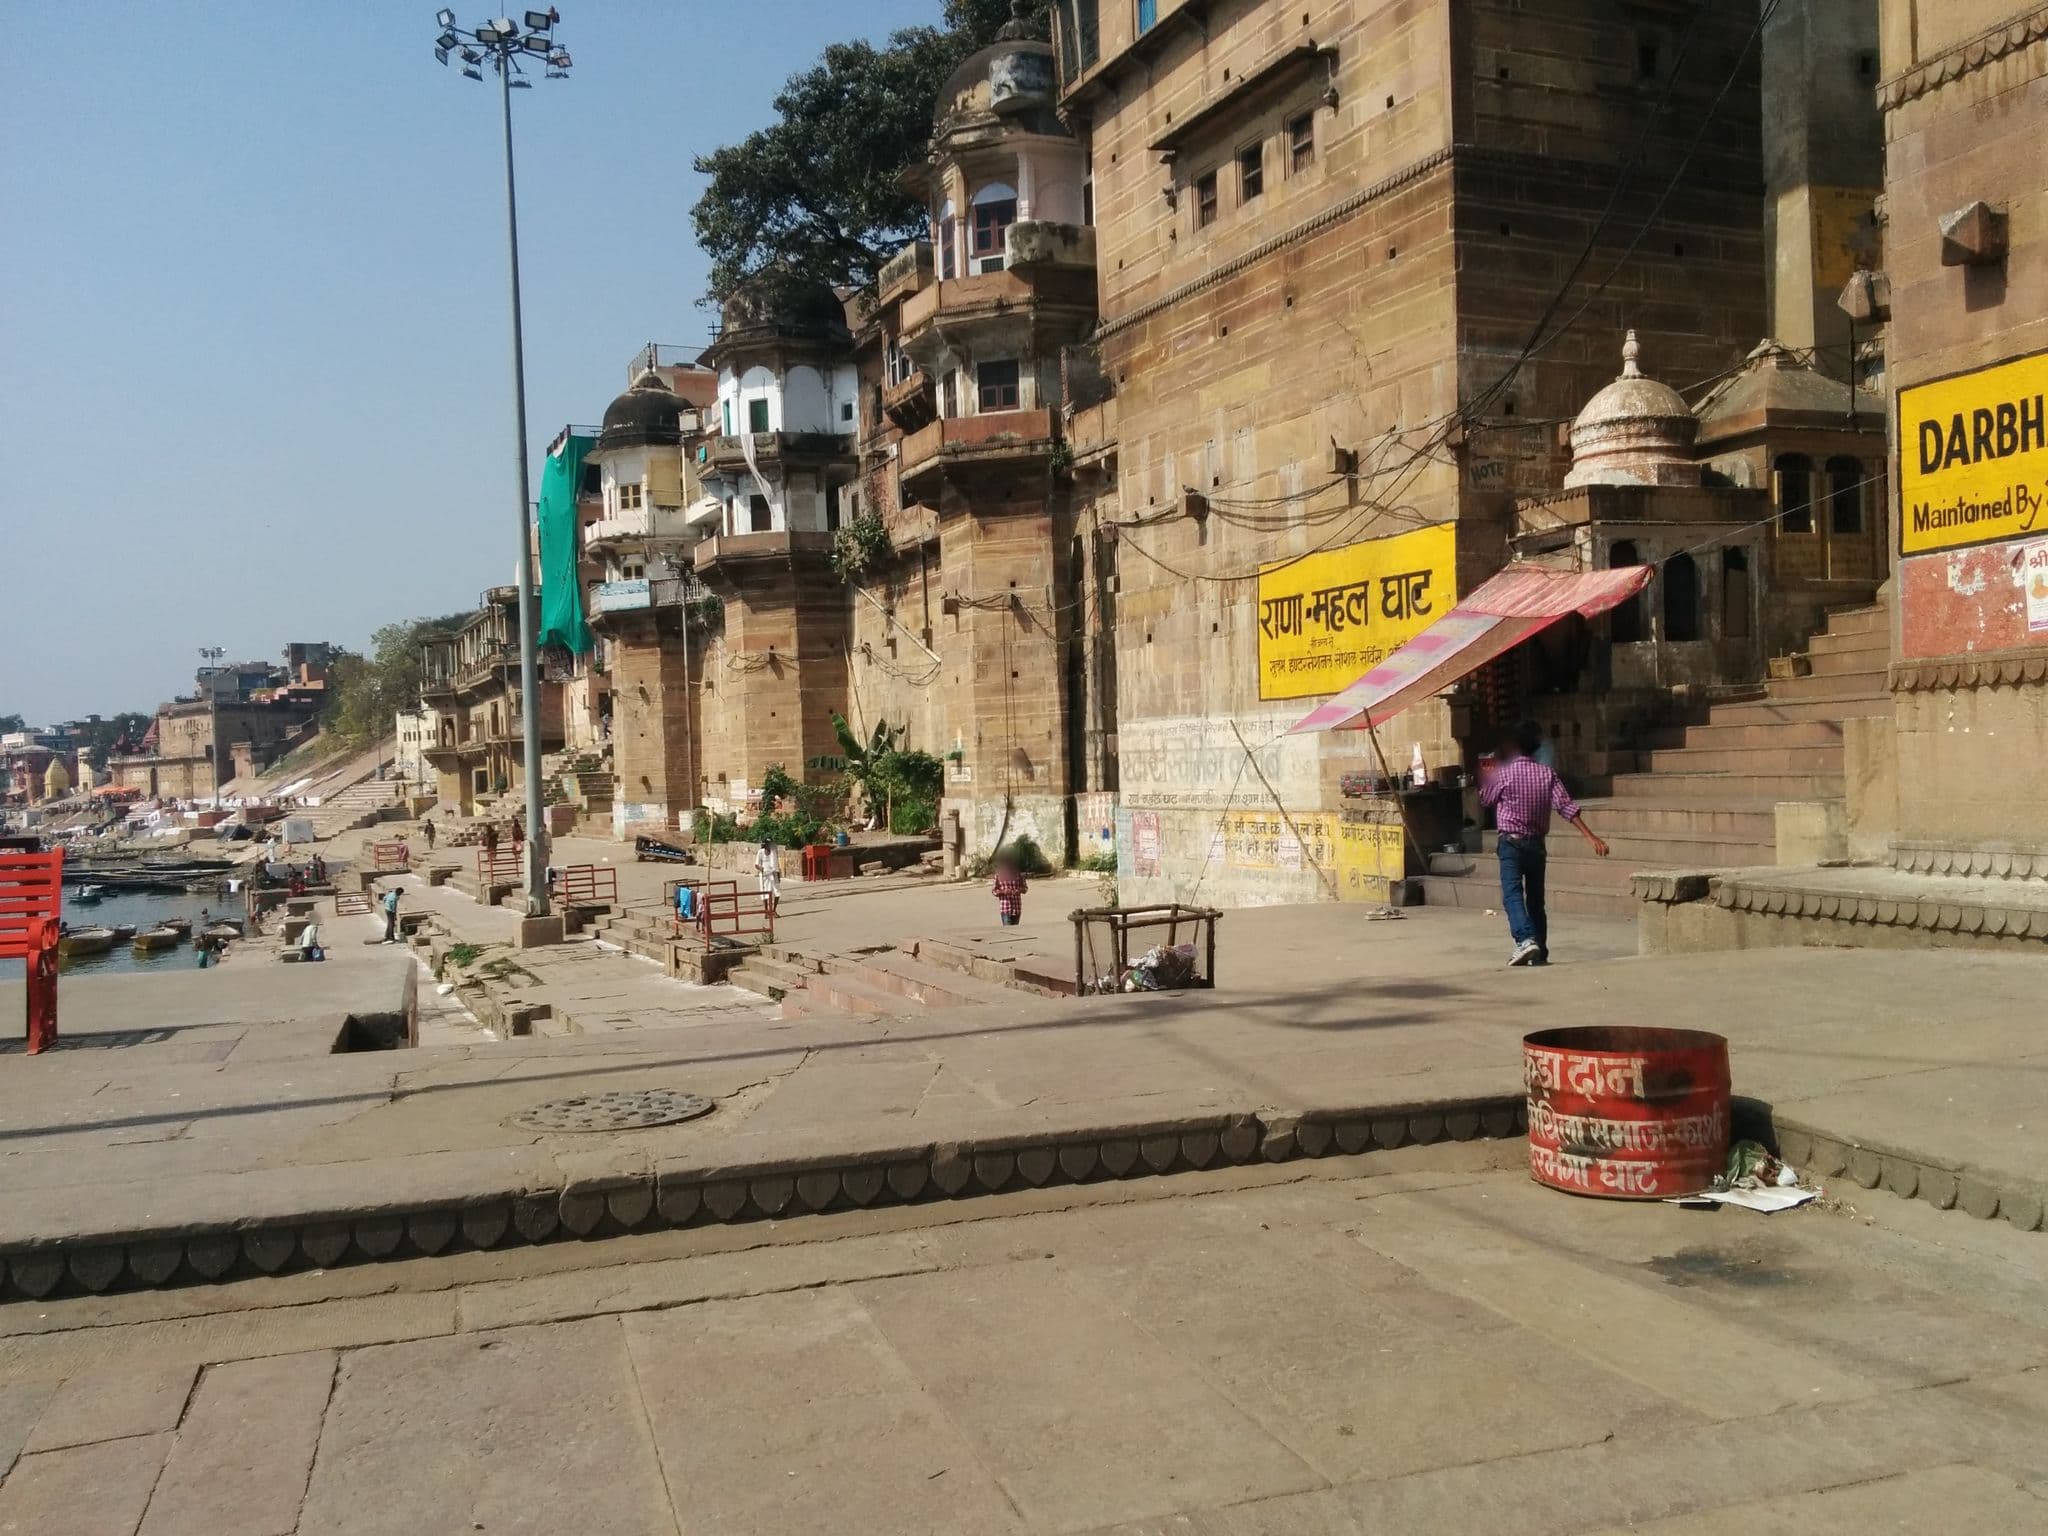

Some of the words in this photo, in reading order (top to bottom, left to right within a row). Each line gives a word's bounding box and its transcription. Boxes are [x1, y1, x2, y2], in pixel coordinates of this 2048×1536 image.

[1919, 395, 2048, 475] DARBH
[1913, 487, 2012, 533] Maintained
[2016, 484, 2043, 531] By
[1380, 569, 1433, 620] घाट
[1596, 1159, 1660, 1193] घाट
